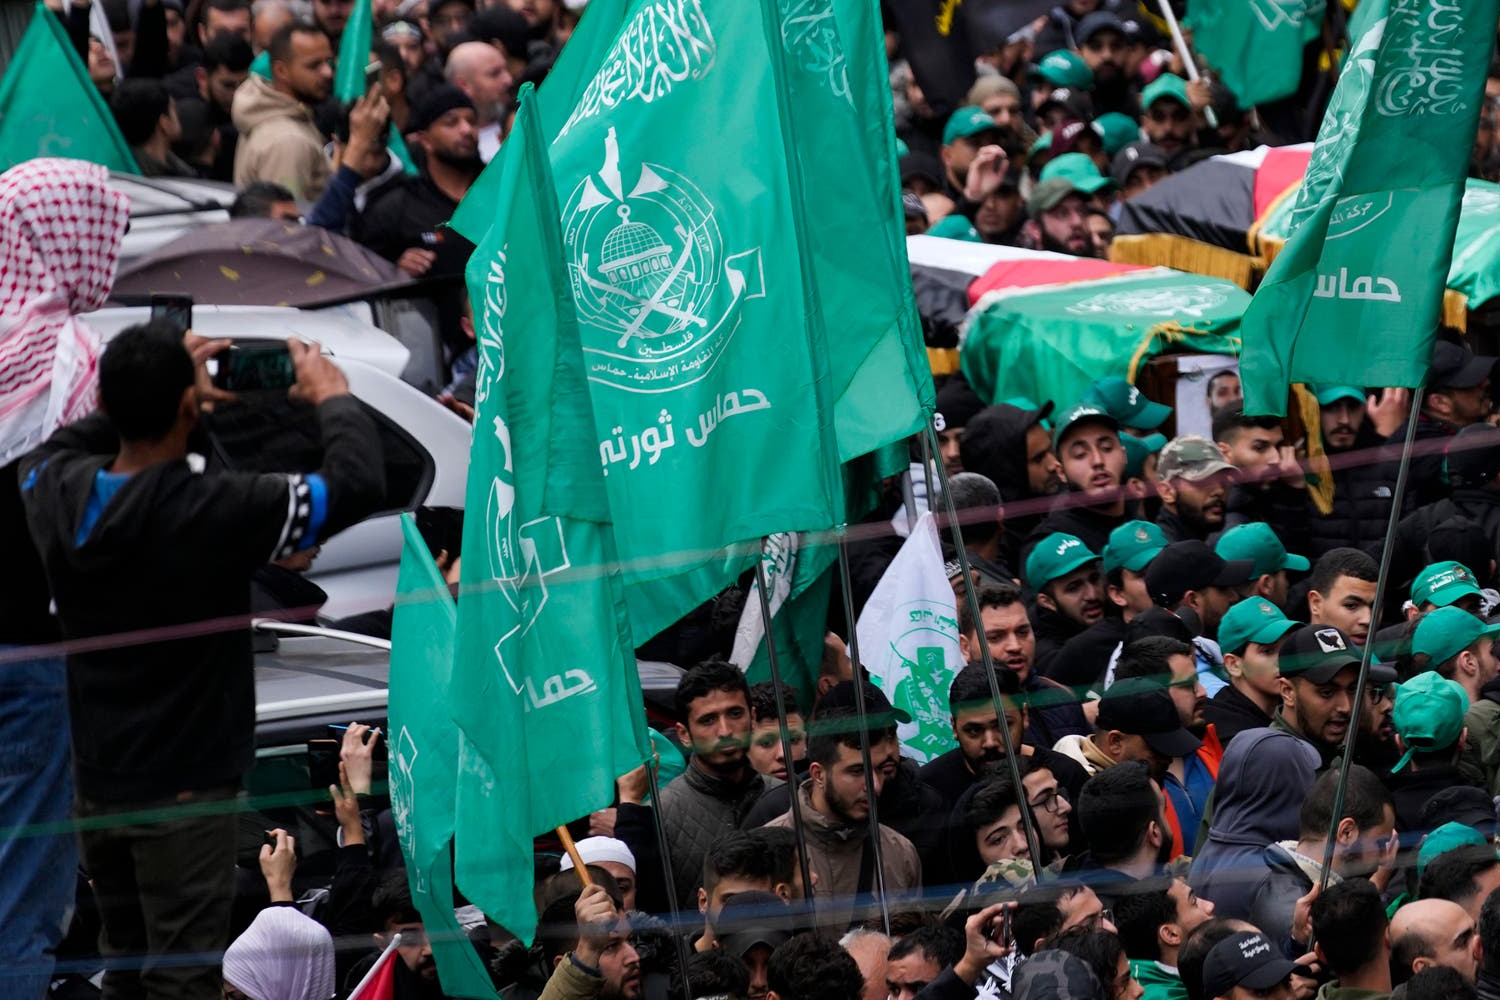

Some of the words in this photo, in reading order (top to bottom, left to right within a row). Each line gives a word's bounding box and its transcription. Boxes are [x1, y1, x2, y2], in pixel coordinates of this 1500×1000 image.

[638, 330, 695, 358] فلسطين
[633, 363, 680, 384] الإسلامية
[685, 388, 772, 449] حماس
[523, 664, 597, 713] حما
